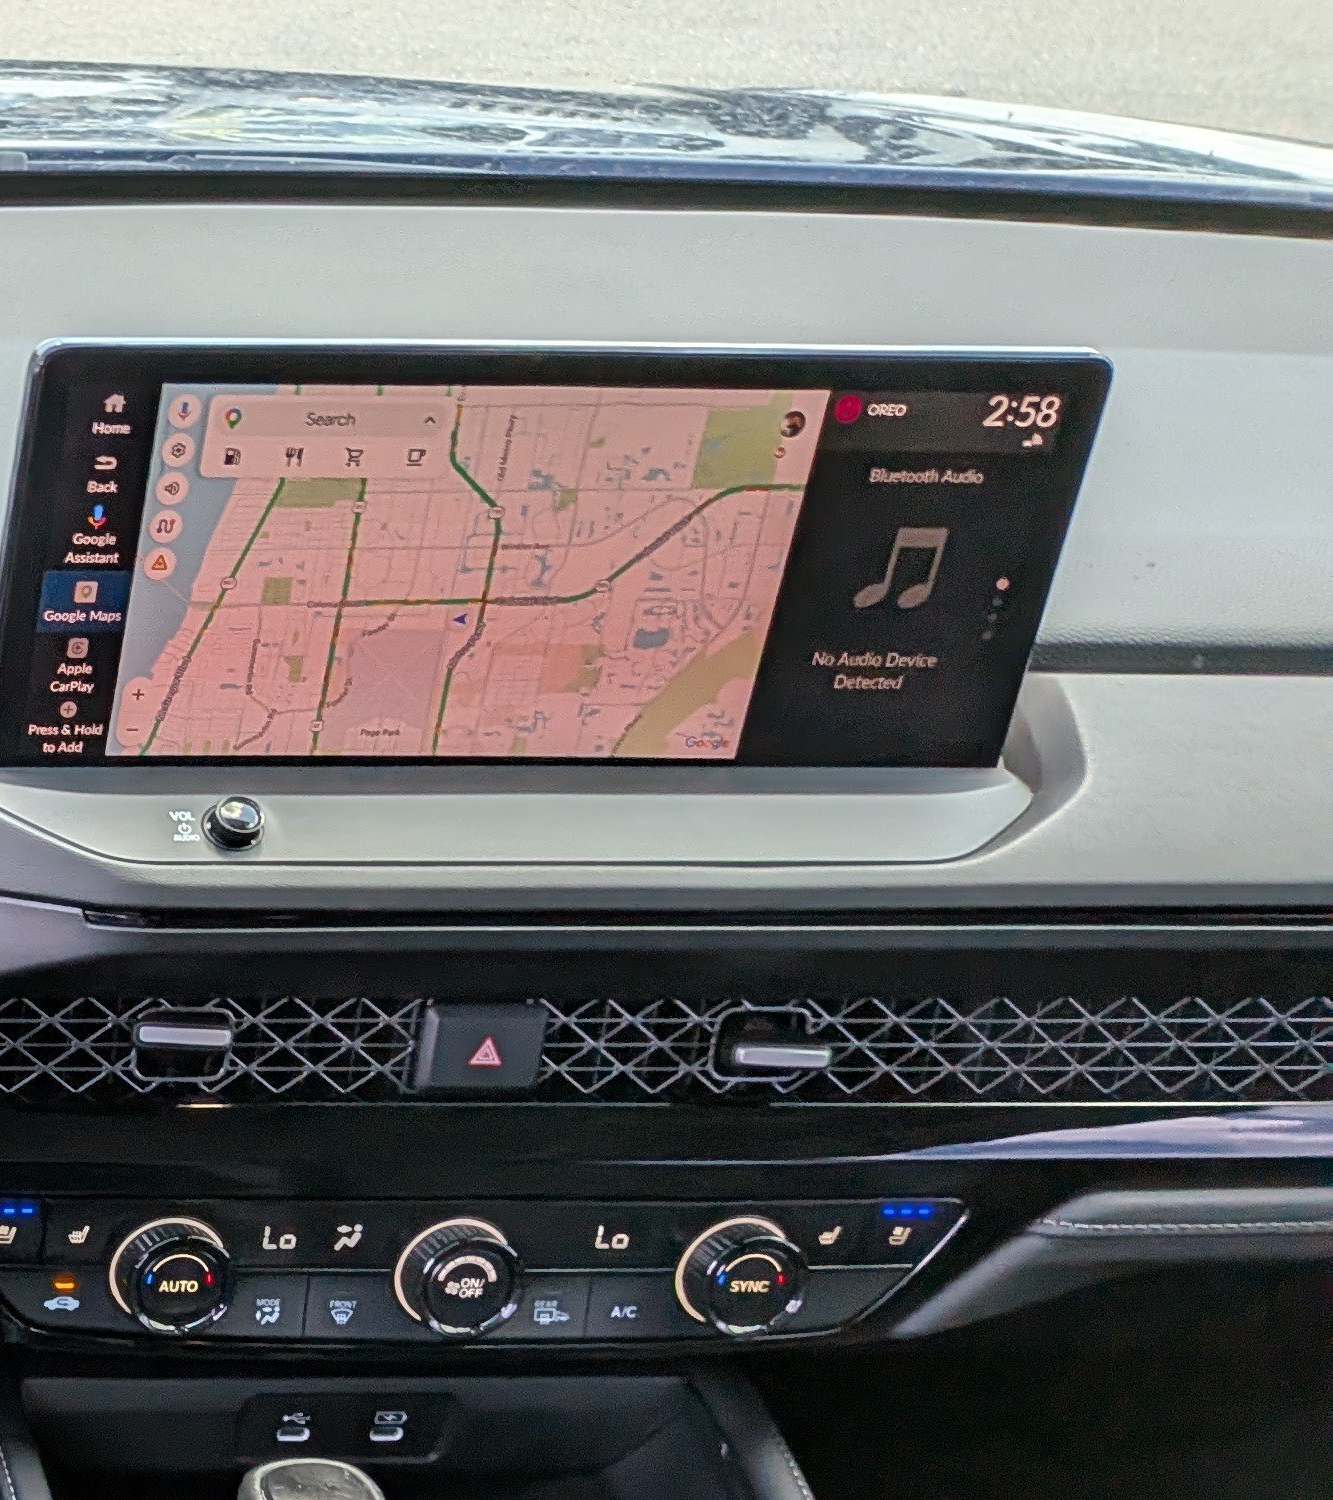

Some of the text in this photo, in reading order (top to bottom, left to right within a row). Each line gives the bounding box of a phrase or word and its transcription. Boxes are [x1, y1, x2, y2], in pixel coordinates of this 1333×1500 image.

[983, 395, 1061, 428] 2:58
[305, 411, 356, 428] Search
[91, 421, 131, 435] Home
[869, 468, 984, 484] Bluetooth Audio
[87, 480, 118, 494] Back
[72, 532, 117, 547] Google
[65, 551, 119, 564] Assistant
[43, 609, 122, 624] Google Maps
[811, 651, 938, 668] No Audio Device
[56, 662, 93, 676] Apple
[49, 680, 95, 694] CarPlay
[833, 674, 904, 690] Detected
[27, 723, 104, 736] Press & Hold
[42, 741, 84, 754] to Add
[169, 811, 196, 822] VOL
[158, 1279, 199, 1293] AUTO
[729, 1279, 772, 1293] SYNC
[458, 1287, 484, 1300] OFF
[609, 1305, 639, 1319] A/C
